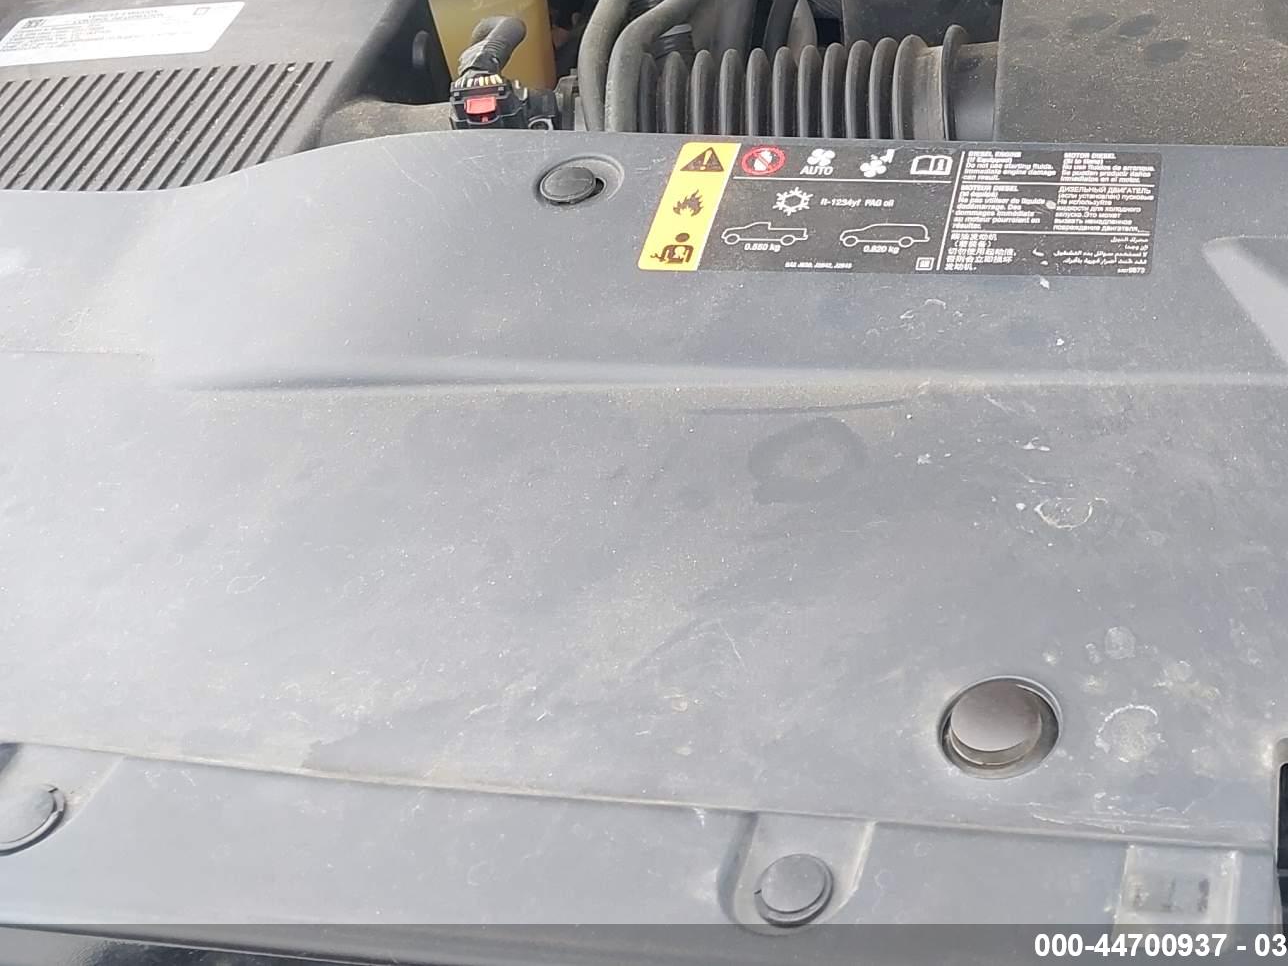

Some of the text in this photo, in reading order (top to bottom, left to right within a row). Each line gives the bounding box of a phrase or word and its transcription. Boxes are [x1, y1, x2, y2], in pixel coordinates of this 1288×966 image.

[800, 166, 833, 175] AUTO
[769, 244, 781, 252] kg
[888, 246, 899, 254] kg
